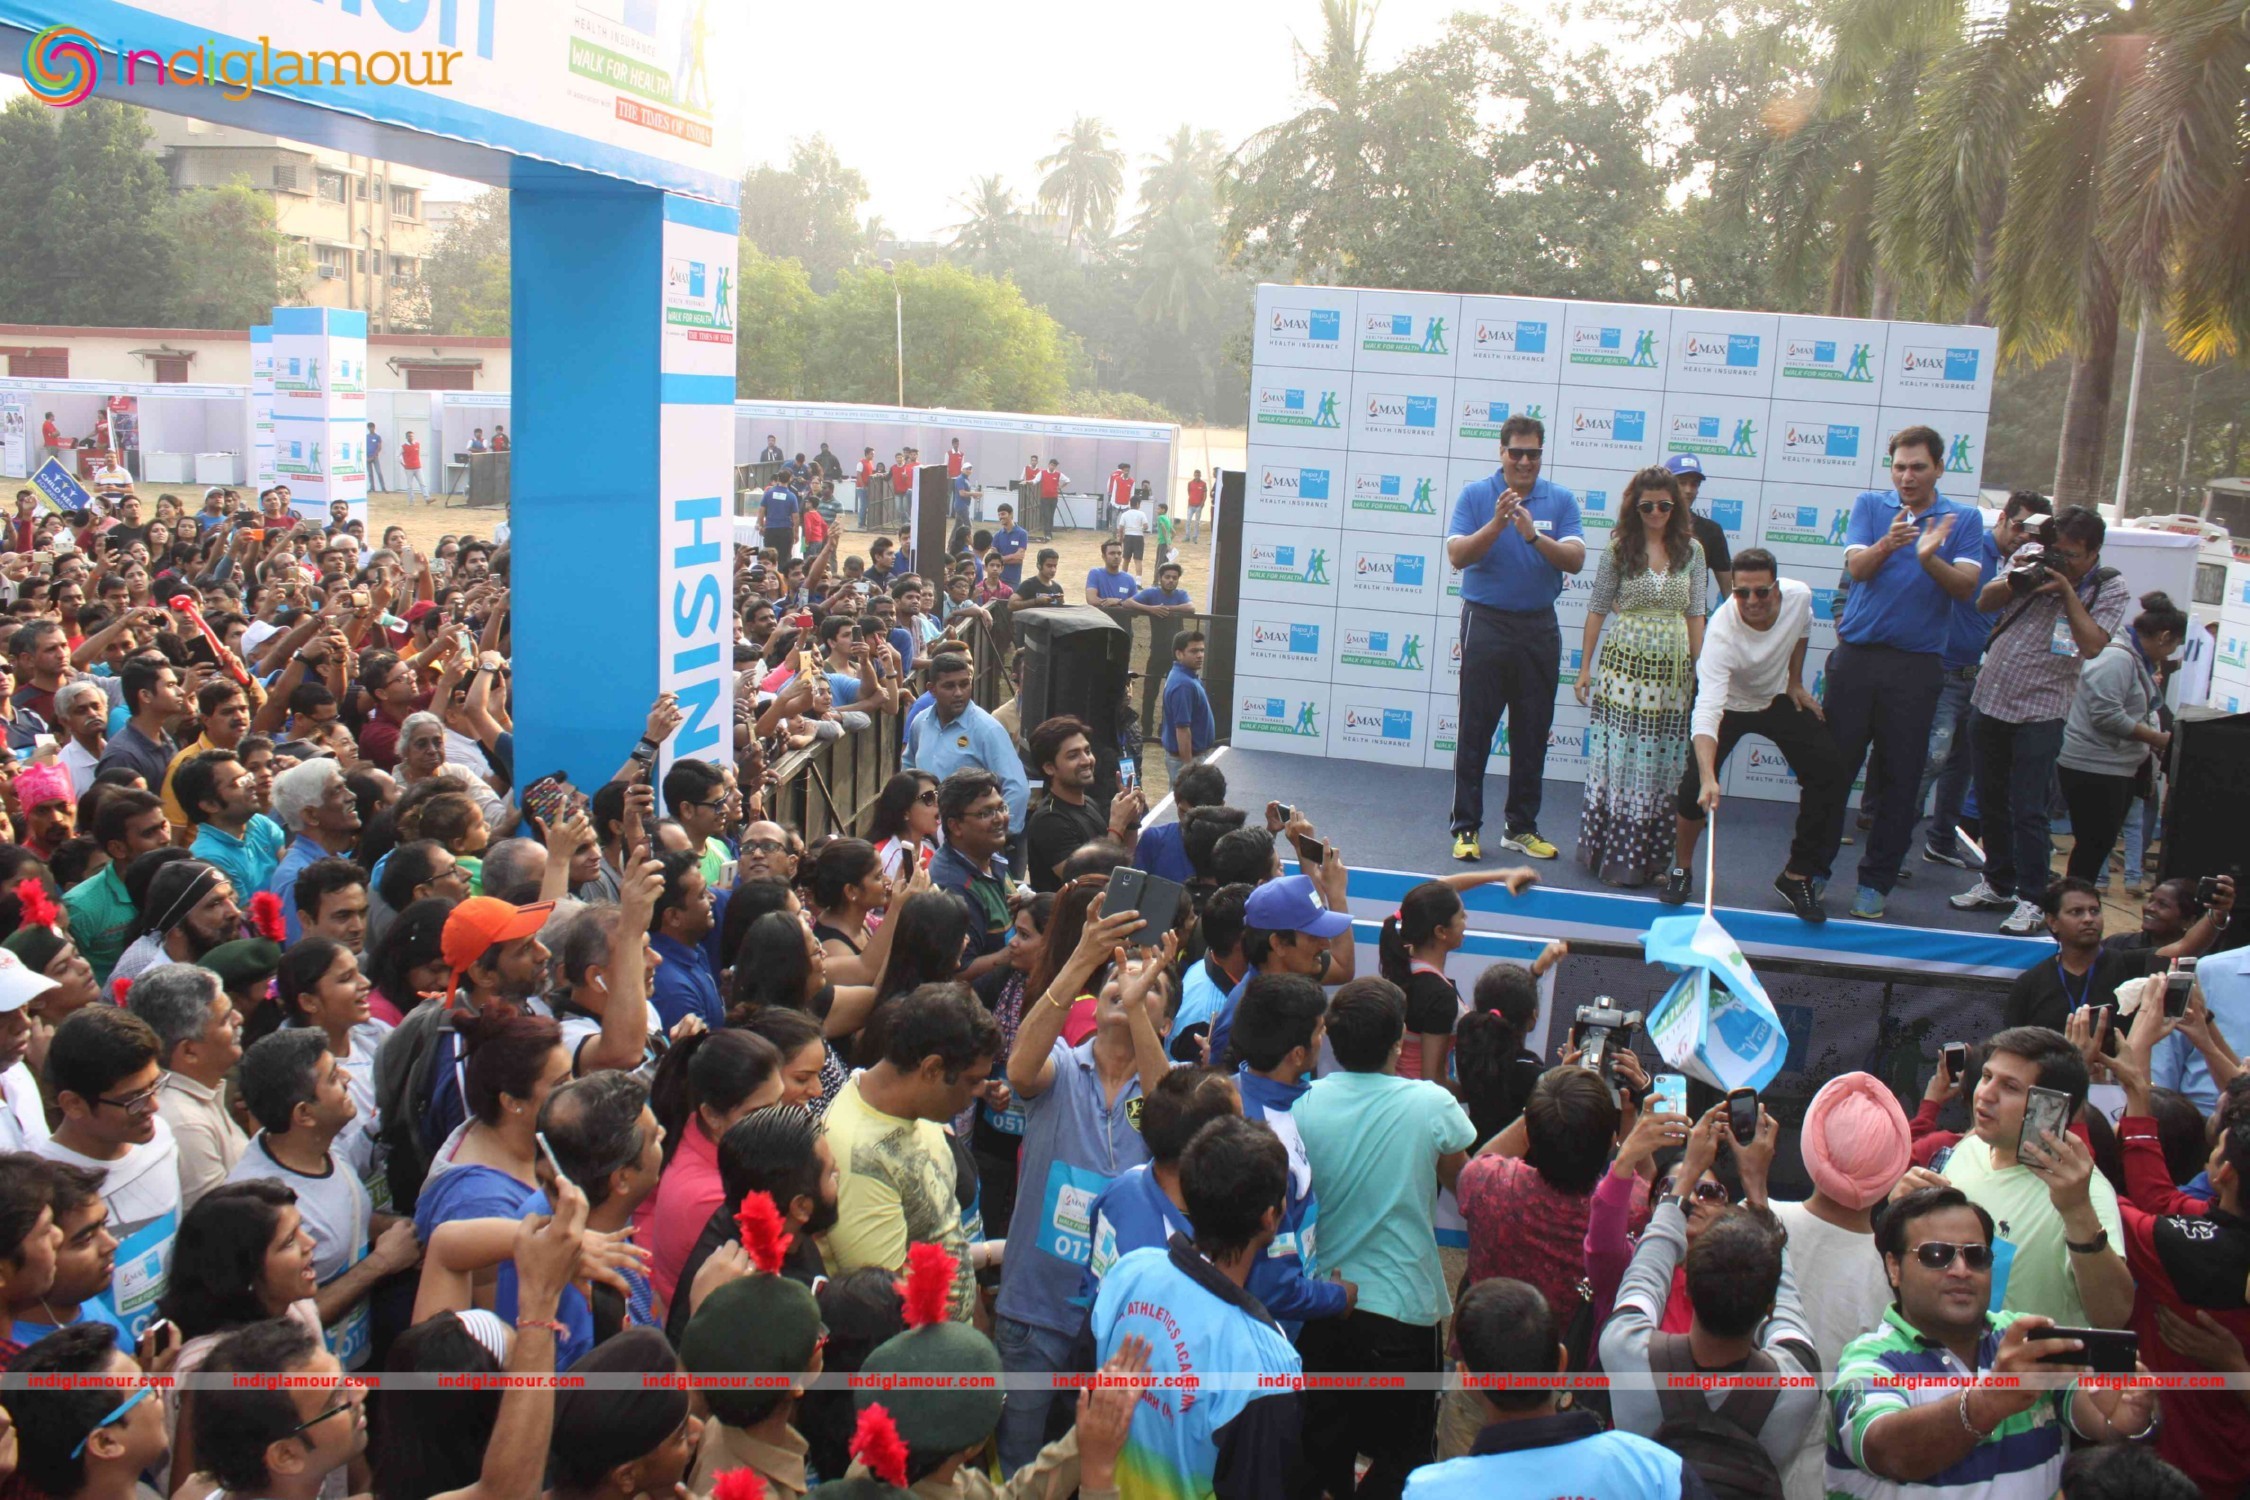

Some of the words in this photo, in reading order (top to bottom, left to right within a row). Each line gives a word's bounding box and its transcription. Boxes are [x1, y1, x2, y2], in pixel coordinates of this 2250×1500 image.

[574, 17, 608, 36] HEALTH
[610, 30, 656, 58] INSURANCE
[572, 44, 604, 74] WALK
[606, 58, 628, 84] FOR
[630, 68, 671, 98] HEALTH
[620, 100, 639, 120] THE
[640, 107, 670, 131] TIMES
[671, 118, 684, 135] OF
[676, 271, 689, 284] MAX
[668, 311, 682, 320] WALK
[683, 312, 693, 322] FOR
[694, 314, 712, 325] HEALTH
[1282, 318, 1309, 329] MAX
[1488, 329, 1515, 341] MAX
[1298, 341, 1339, 350] INSURANCE
[1698, 343, 1727, 355] MAX
[1504, 354, 1546, 362] INSURANCE
[1915, 356, 1944, 368] MAX
[1715, 368, 1758, 376] INSURANCE
[1932, 381, 1976, 390] INSURANCE
[1378, 403, 1405, 415] MAX
[1585, 418, 1612, 429] MAX
[1394, 427, 1435, 436] INSURANCE
[1797, 433, 1826, 445] MAX
[1601, 442, 1643, 450] INSURANCE
[1813, 457, 1857, 466] INSURANCE
[1272, 476, 1298, 487] MAX
[40, 473, 61, 494] CHILD
[60, 492, 78, 510] HELP
[1288, 499, 1328, 508] INSURANCE
[1367, 561, 1393, 573] MAX
[1383, 584, 1423, 593] INSURANCE
[1263, 630, 1289, 642] MAX
[1278, 653, 1318, 662] INSURANCE
[1356, 715, 1382, 727] MAX
[1371, 738, 1411, 747] INSURANCE
[1556, 735, 1582, 746] MAX
[1058, 1216, 1074, 1229] WALK
[1074, 1220, 1088, 1232] FOR
[1128, 1301, 1181, 1340] ATHLETICS
